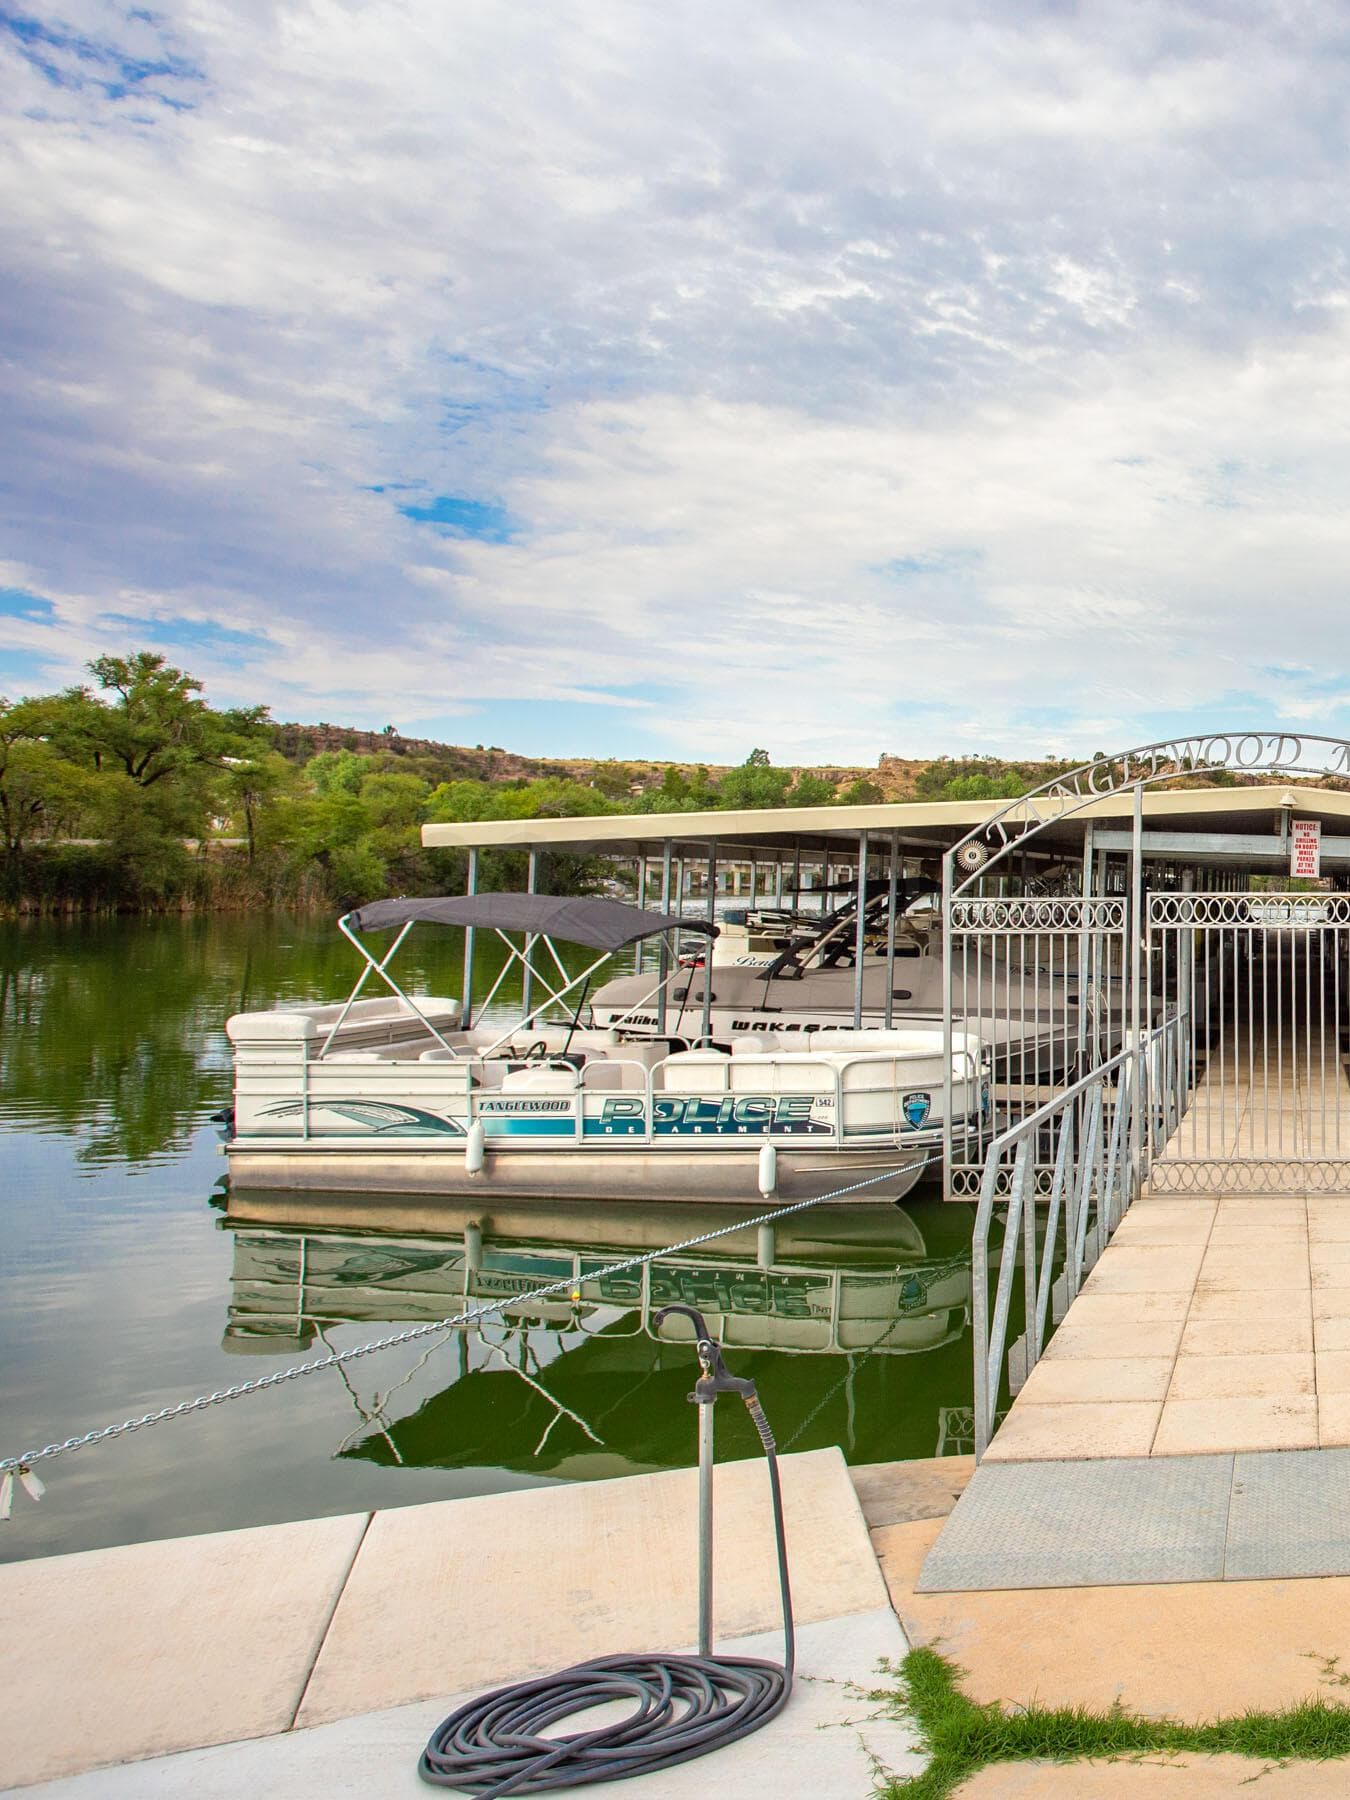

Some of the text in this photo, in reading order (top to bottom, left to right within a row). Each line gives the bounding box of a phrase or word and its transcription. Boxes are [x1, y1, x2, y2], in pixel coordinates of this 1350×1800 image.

[985, 734, 1302, 849] TANGLEWOOD
[1295, 823, 1318, 831] NOTICE:
[478, 1100, 571, 1112] TANGLEWOOD
[817, 1098, 832, 1106] 542
[599, 1096, 815, 1125] POLICE
[605, 1125, 813, 1134] DEARTMENT
